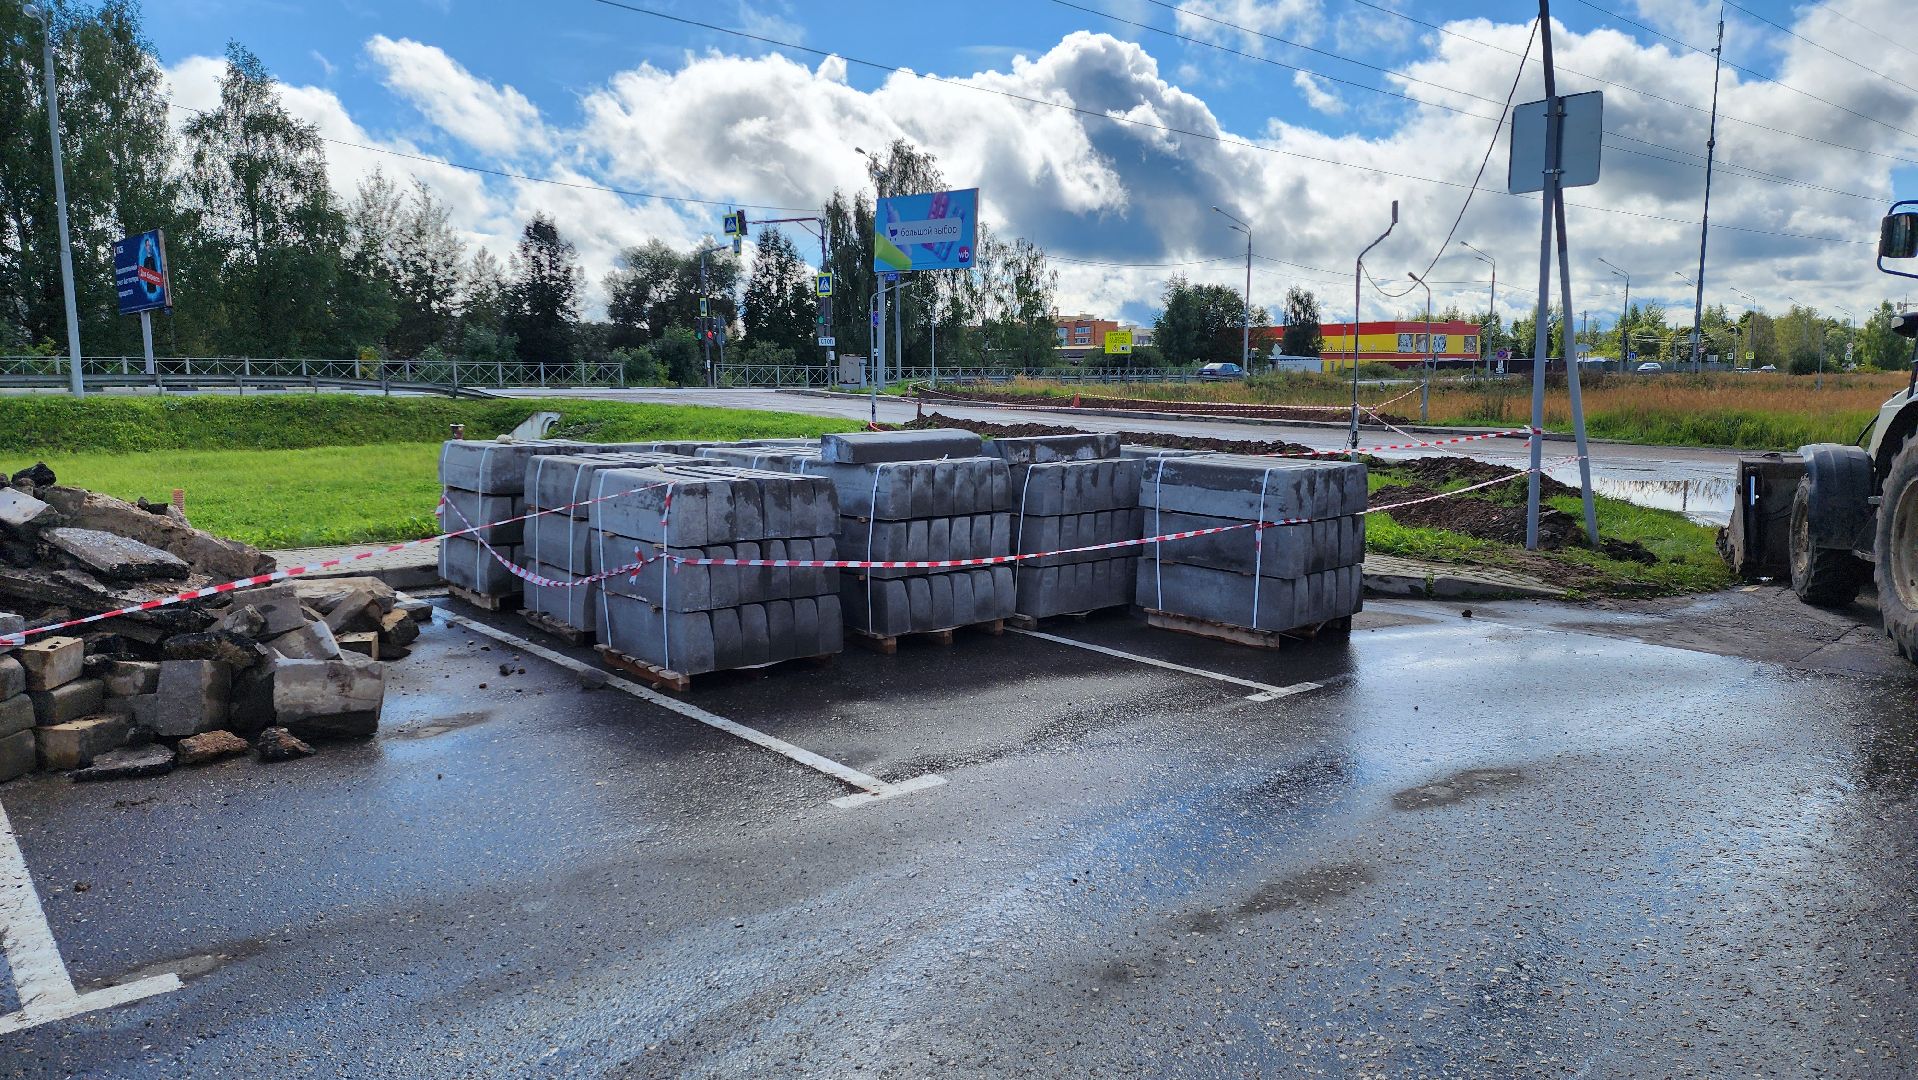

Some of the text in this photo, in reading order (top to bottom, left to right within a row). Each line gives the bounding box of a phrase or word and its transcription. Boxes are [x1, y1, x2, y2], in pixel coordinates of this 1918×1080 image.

[901, 224, 958, 237] большой выбор
[958, 249, 970, 259] wb
